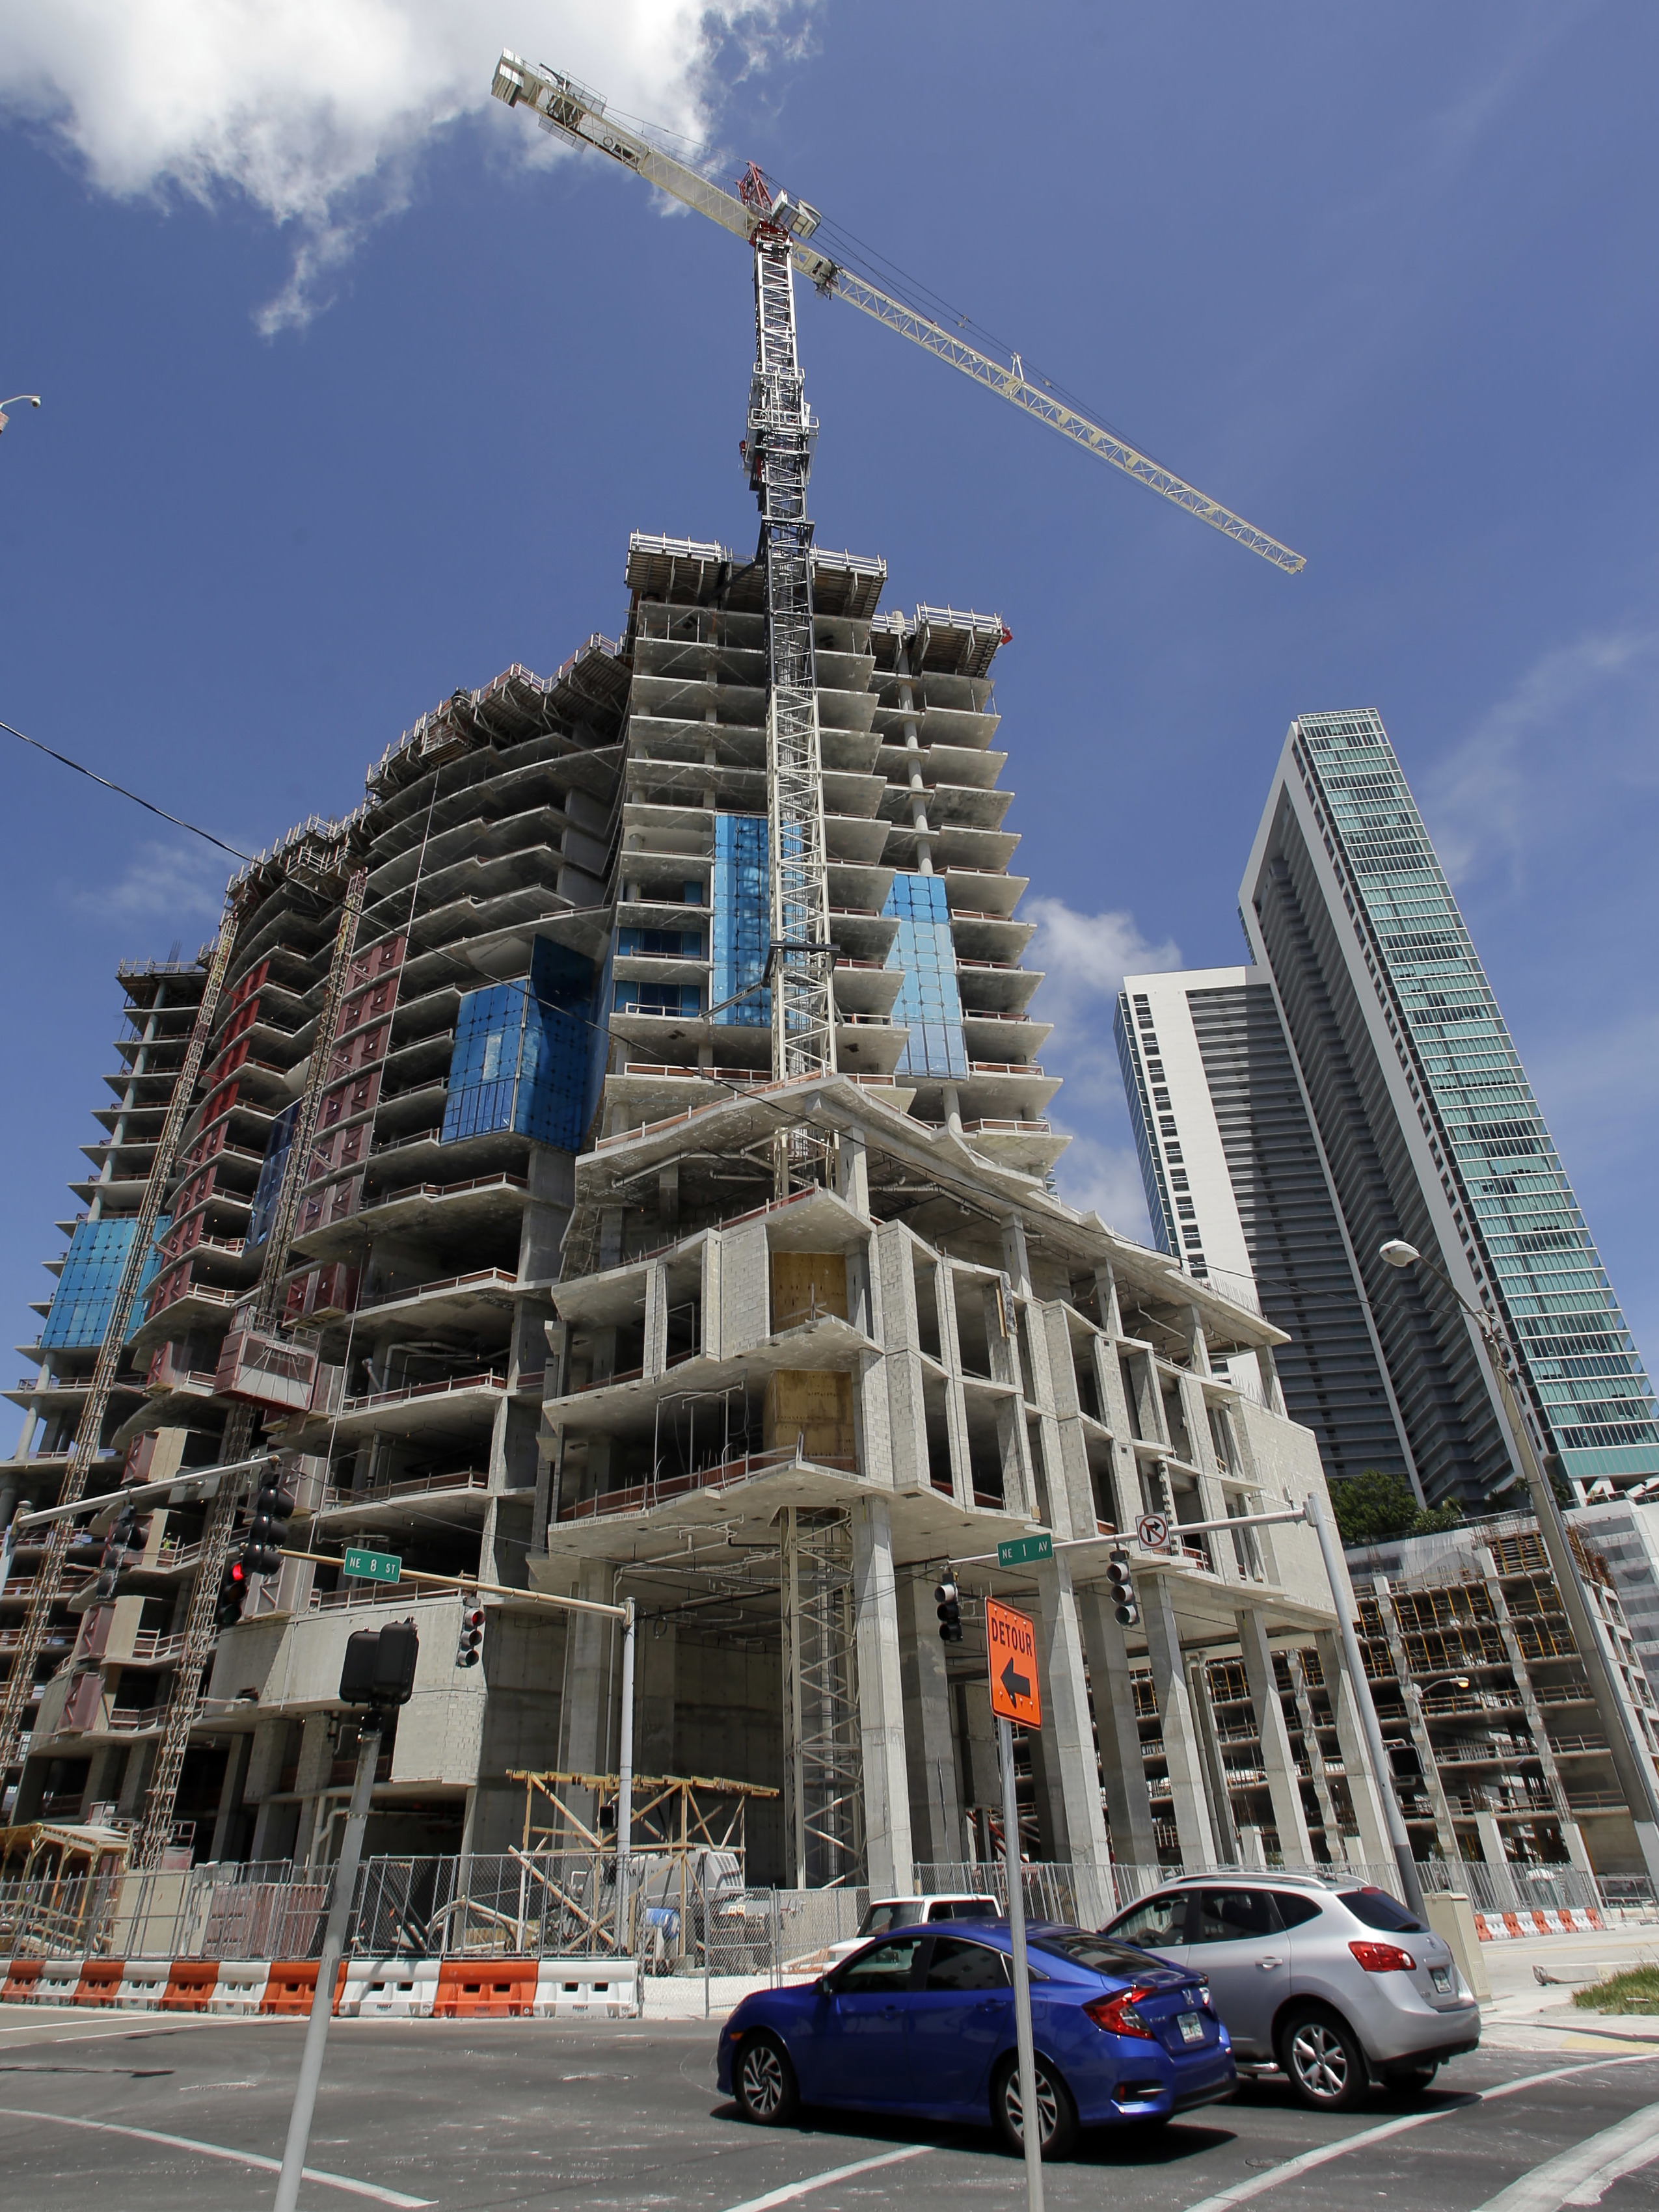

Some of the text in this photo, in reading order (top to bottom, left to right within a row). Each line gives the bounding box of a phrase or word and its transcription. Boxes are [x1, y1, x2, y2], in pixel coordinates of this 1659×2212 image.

[1002, 1541, 1047, 1559] NE 1 AV
[349, 1557, 396, 1574] NE 8 ST
[991, 1617, 1032, 1657] DETOUR
